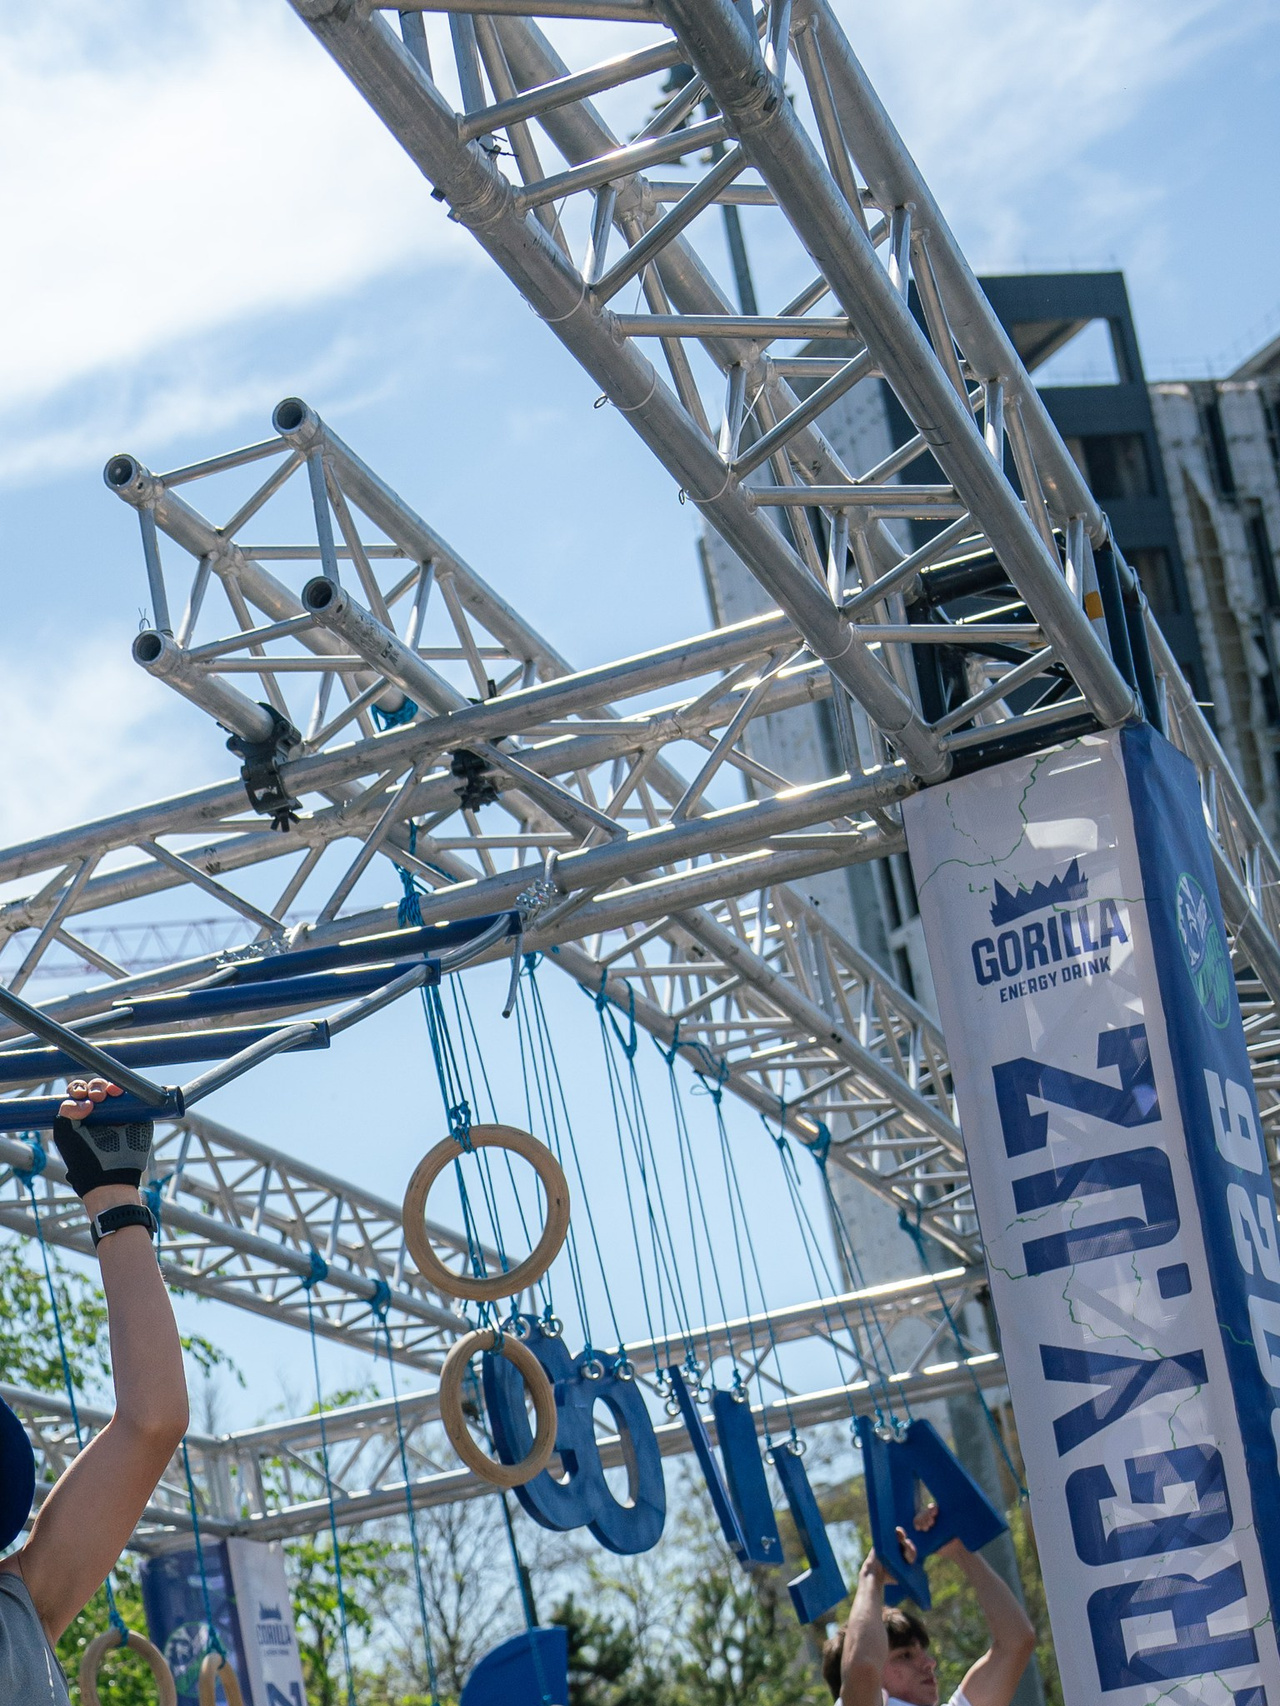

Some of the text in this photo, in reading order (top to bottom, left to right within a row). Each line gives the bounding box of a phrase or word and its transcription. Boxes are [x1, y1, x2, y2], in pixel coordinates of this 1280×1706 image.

[972, 898, 1129, 986] GORILLA
[1000, 956, 1111, 1003] ENERGY DRINK
